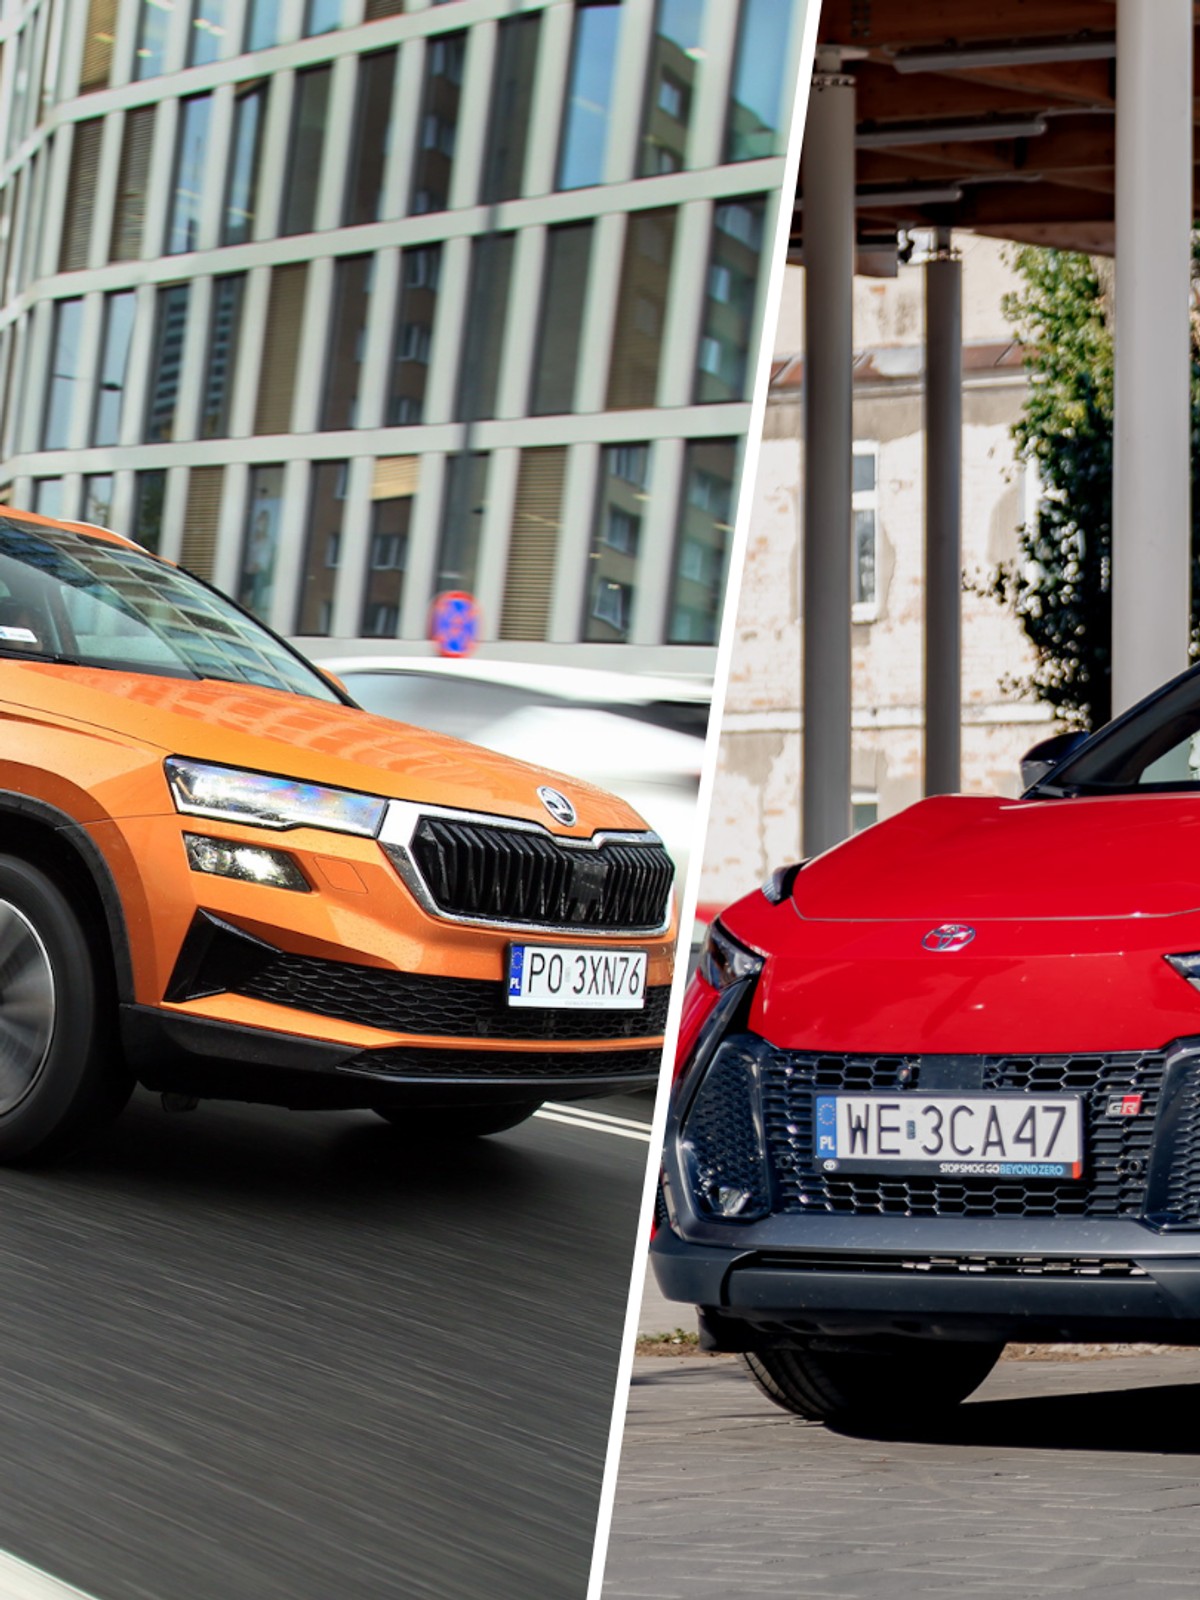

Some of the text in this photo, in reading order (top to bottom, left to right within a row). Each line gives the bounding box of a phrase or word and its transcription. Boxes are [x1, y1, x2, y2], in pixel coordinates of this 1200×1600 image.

[509, 977, 521, 989] PL
[528, 952, 642, 996] PO 3XN76
[1106, 1096, 1141, 1116] GR
[846, 1103, 1067, 1158] WE 3CA47
[819, 1136, 835, 1150] PL
